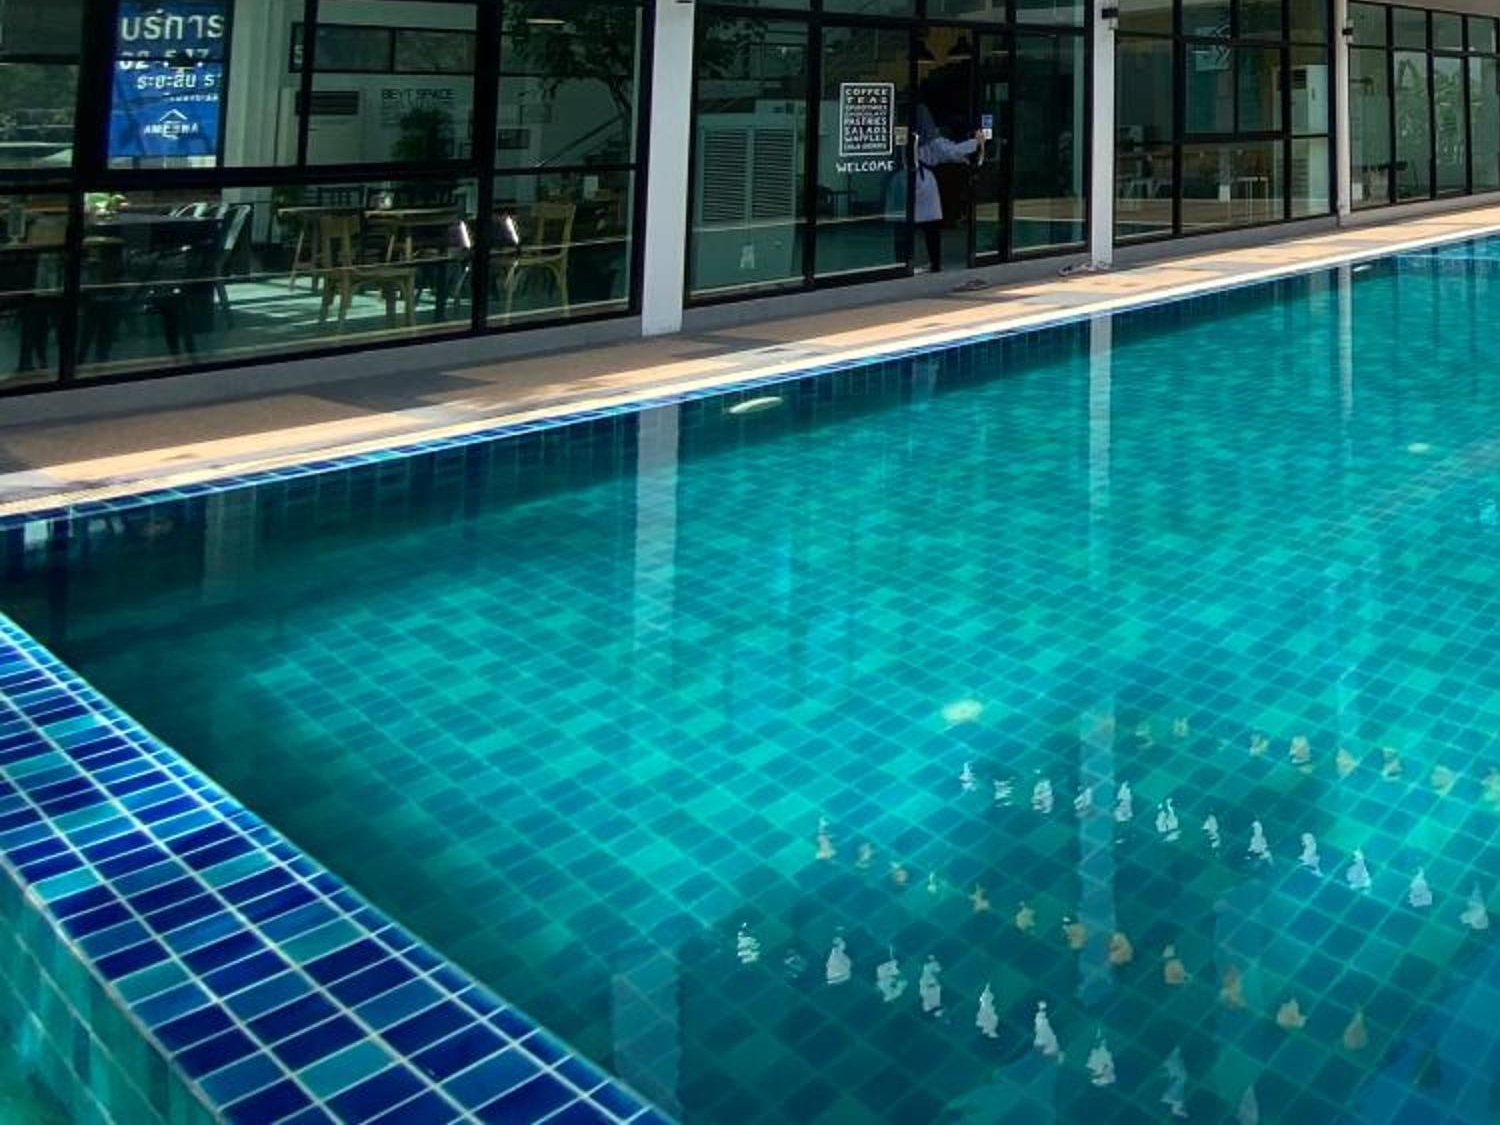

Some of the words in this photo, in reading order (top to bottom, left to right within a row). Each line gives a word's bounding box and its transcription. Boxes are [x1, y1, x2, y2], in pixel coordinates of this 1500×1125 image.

[845, 88, 889, 96] COFFEE
[844, 117, 887, 125] PASTRIES
[844, 126, 887, 134] SALADS
[836, 160, 895, 173] WELCOME
